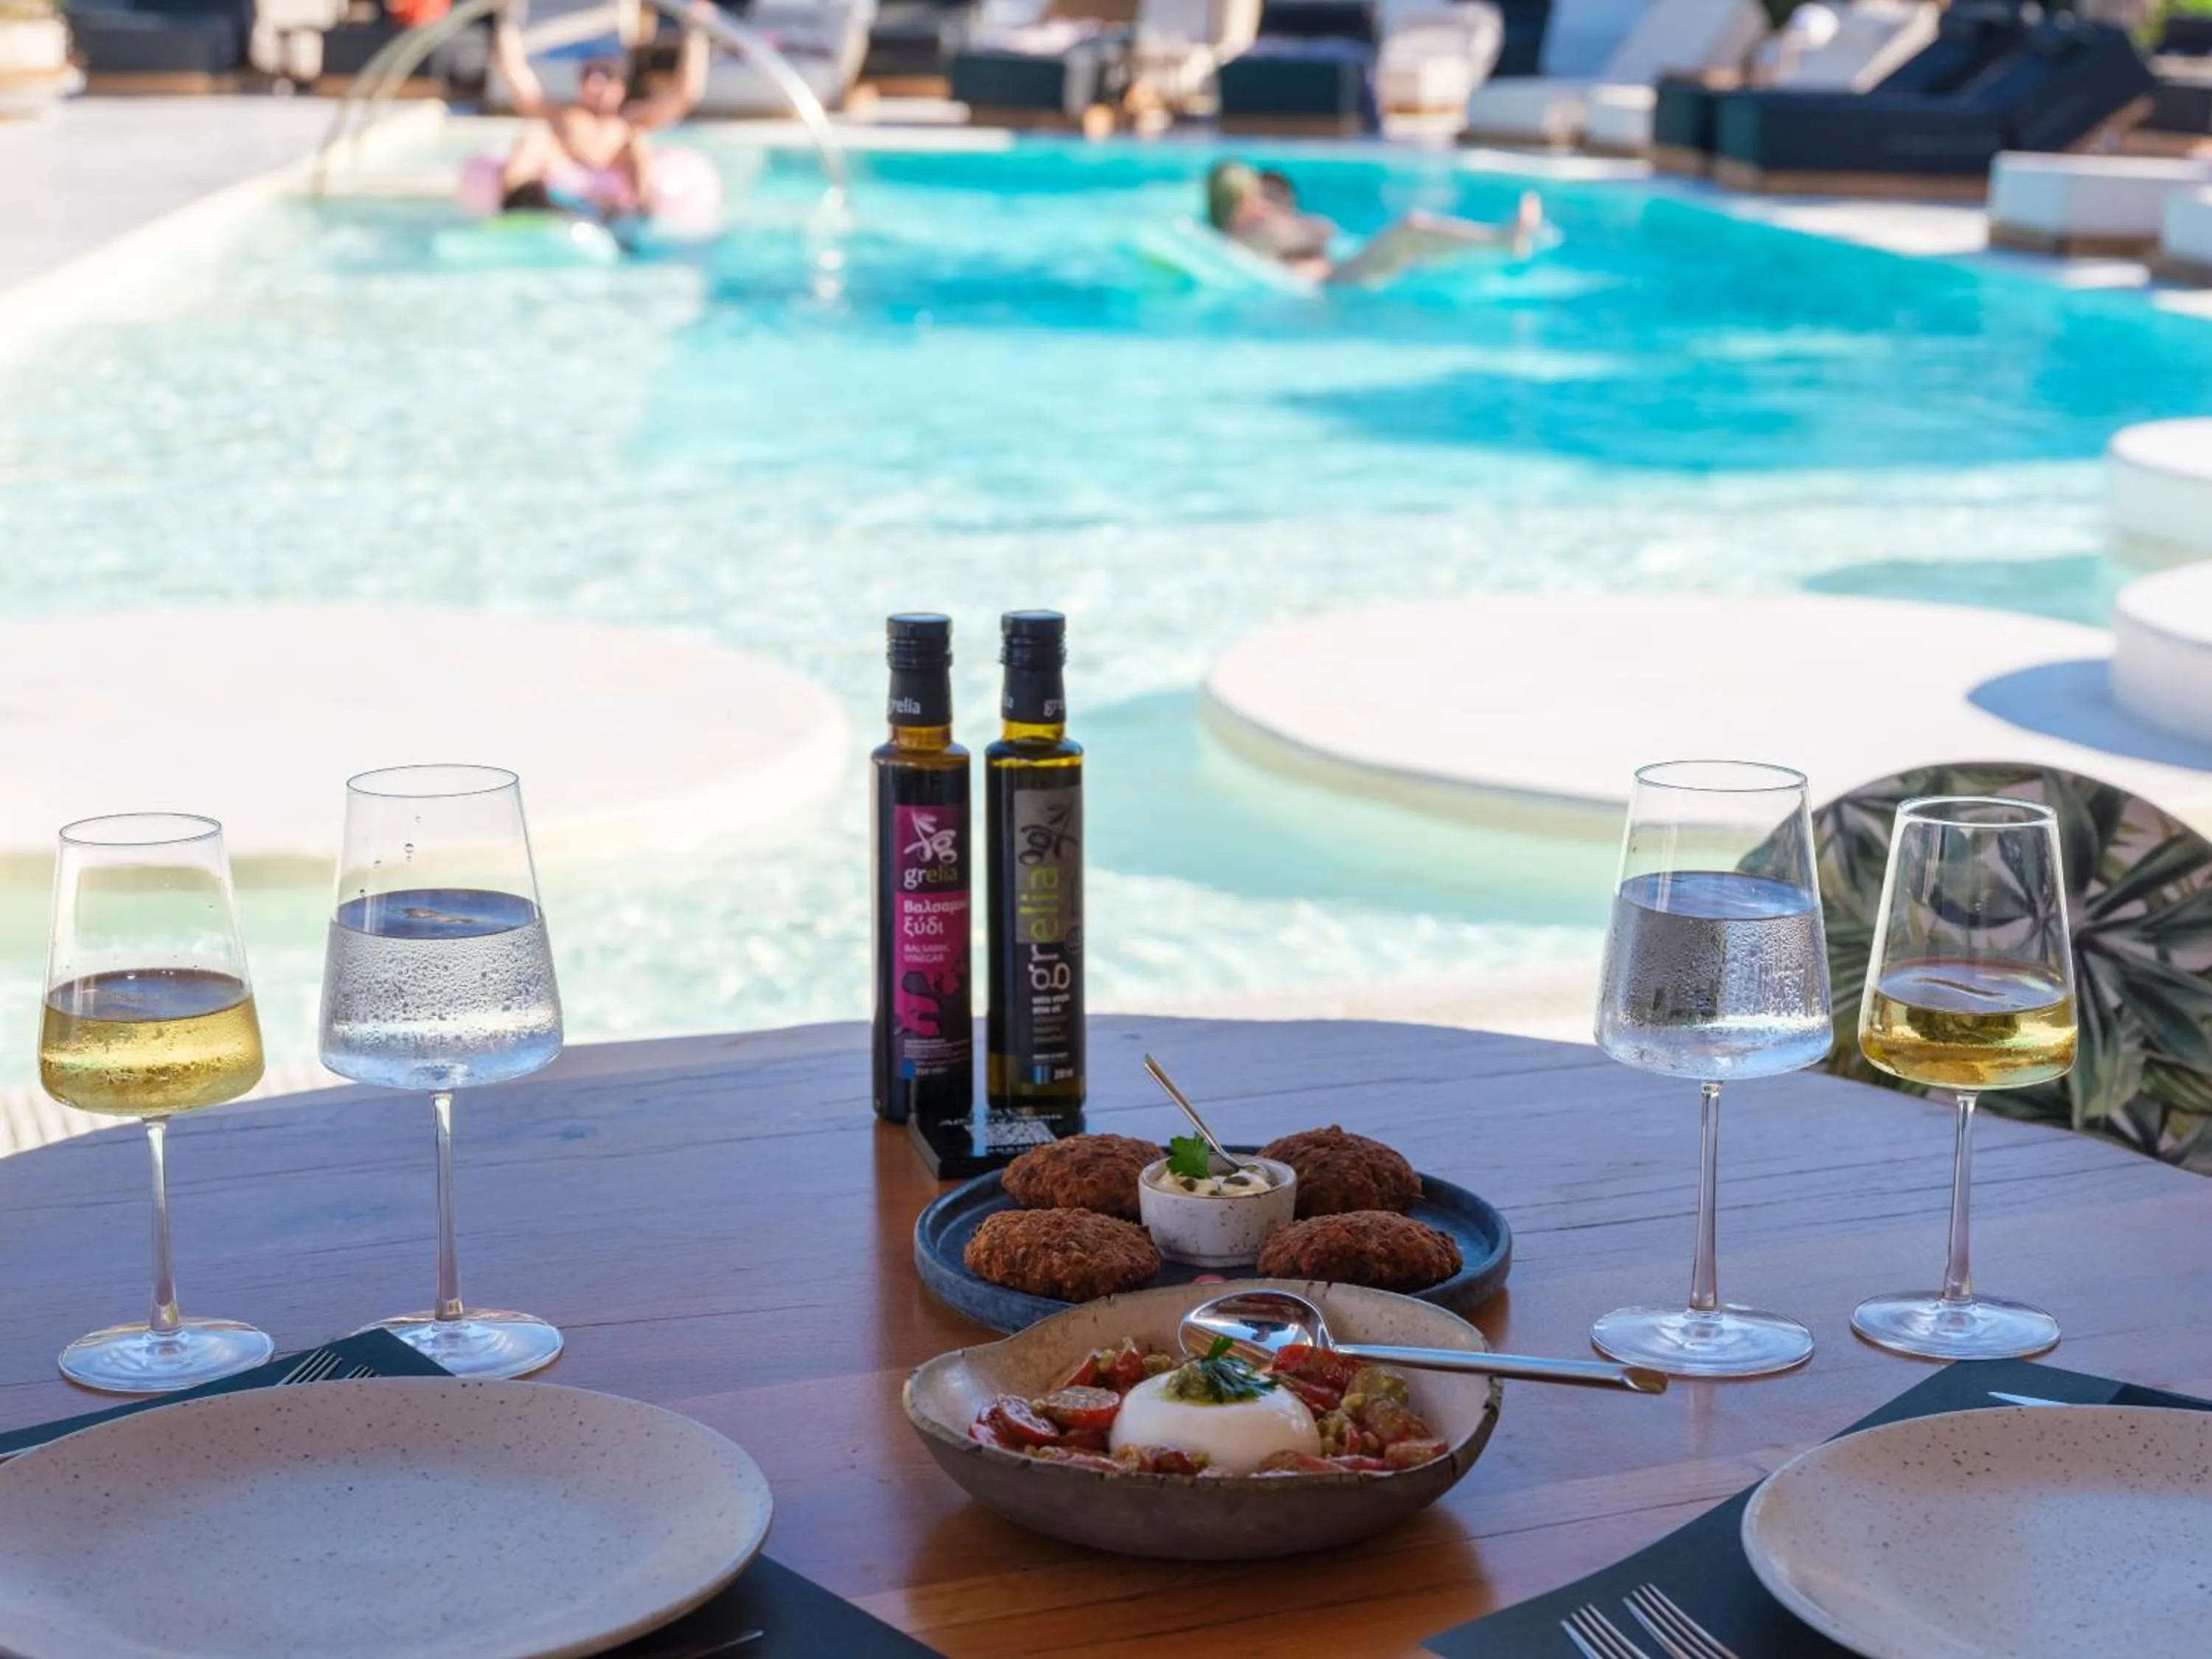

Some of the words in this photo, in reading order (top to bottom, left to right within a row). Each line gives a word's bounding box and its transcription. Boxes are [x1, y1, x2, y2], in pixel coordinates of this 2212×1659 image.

[903, 863, 959, 890] grelia
[903, 916, 944, 936] ξύδι
[1018, 866, 1071, 990] grelia
